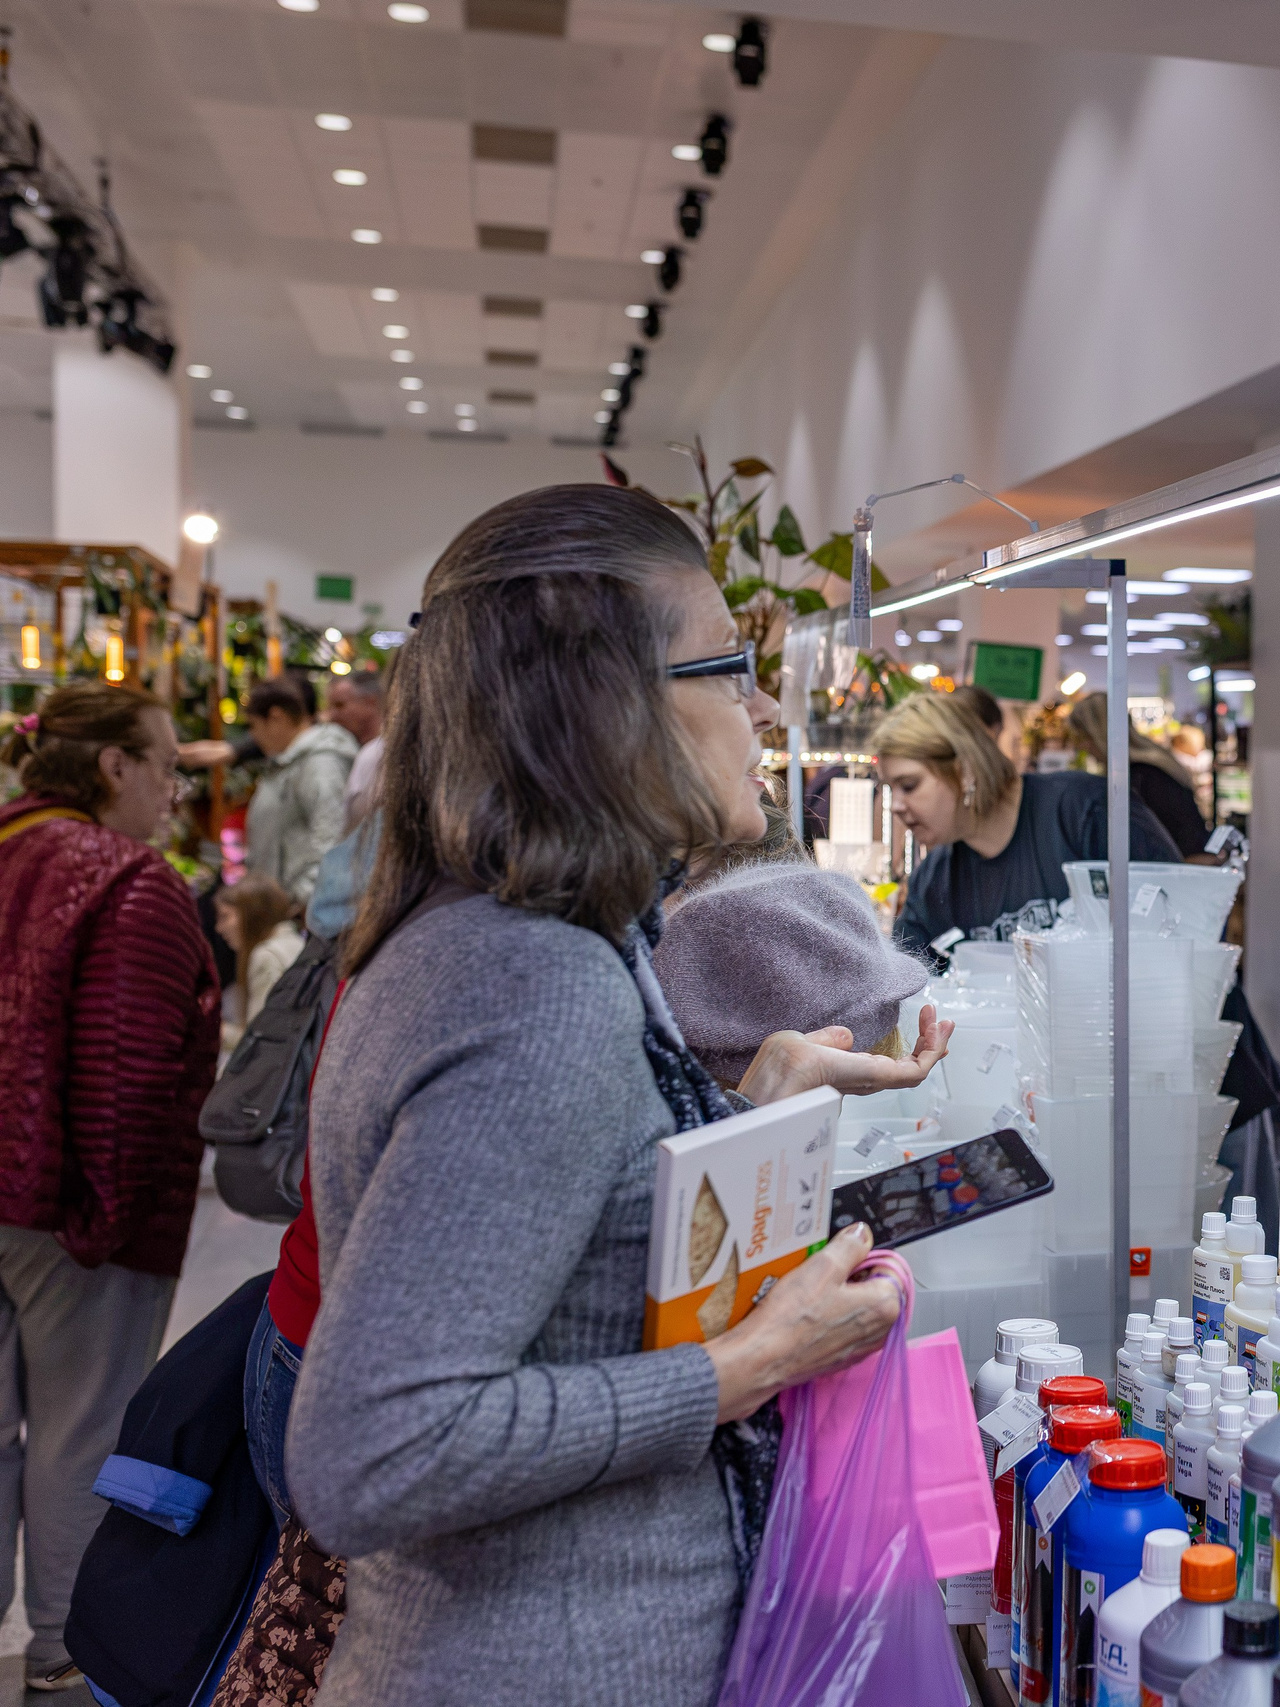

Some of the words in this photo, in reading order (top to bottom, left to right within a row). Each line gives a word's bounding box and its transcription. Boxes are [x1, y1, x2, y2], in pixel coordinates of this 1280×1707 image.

[1210, 1285, 1225, 1294] Плюс
[1133, 1403, 1145, 1414] Force
[1177, 1442, 1197, 1453] Simplex
[1177, 1456, 1192, 1468] Terra
[1177, 1466, 1192, 1477] Vega
[1208, 1463, 1223, 1476] Simplex
[1208, 1480, 1222, 1493] Hydro
[1208, 1490, 1219, 1501] Vega
